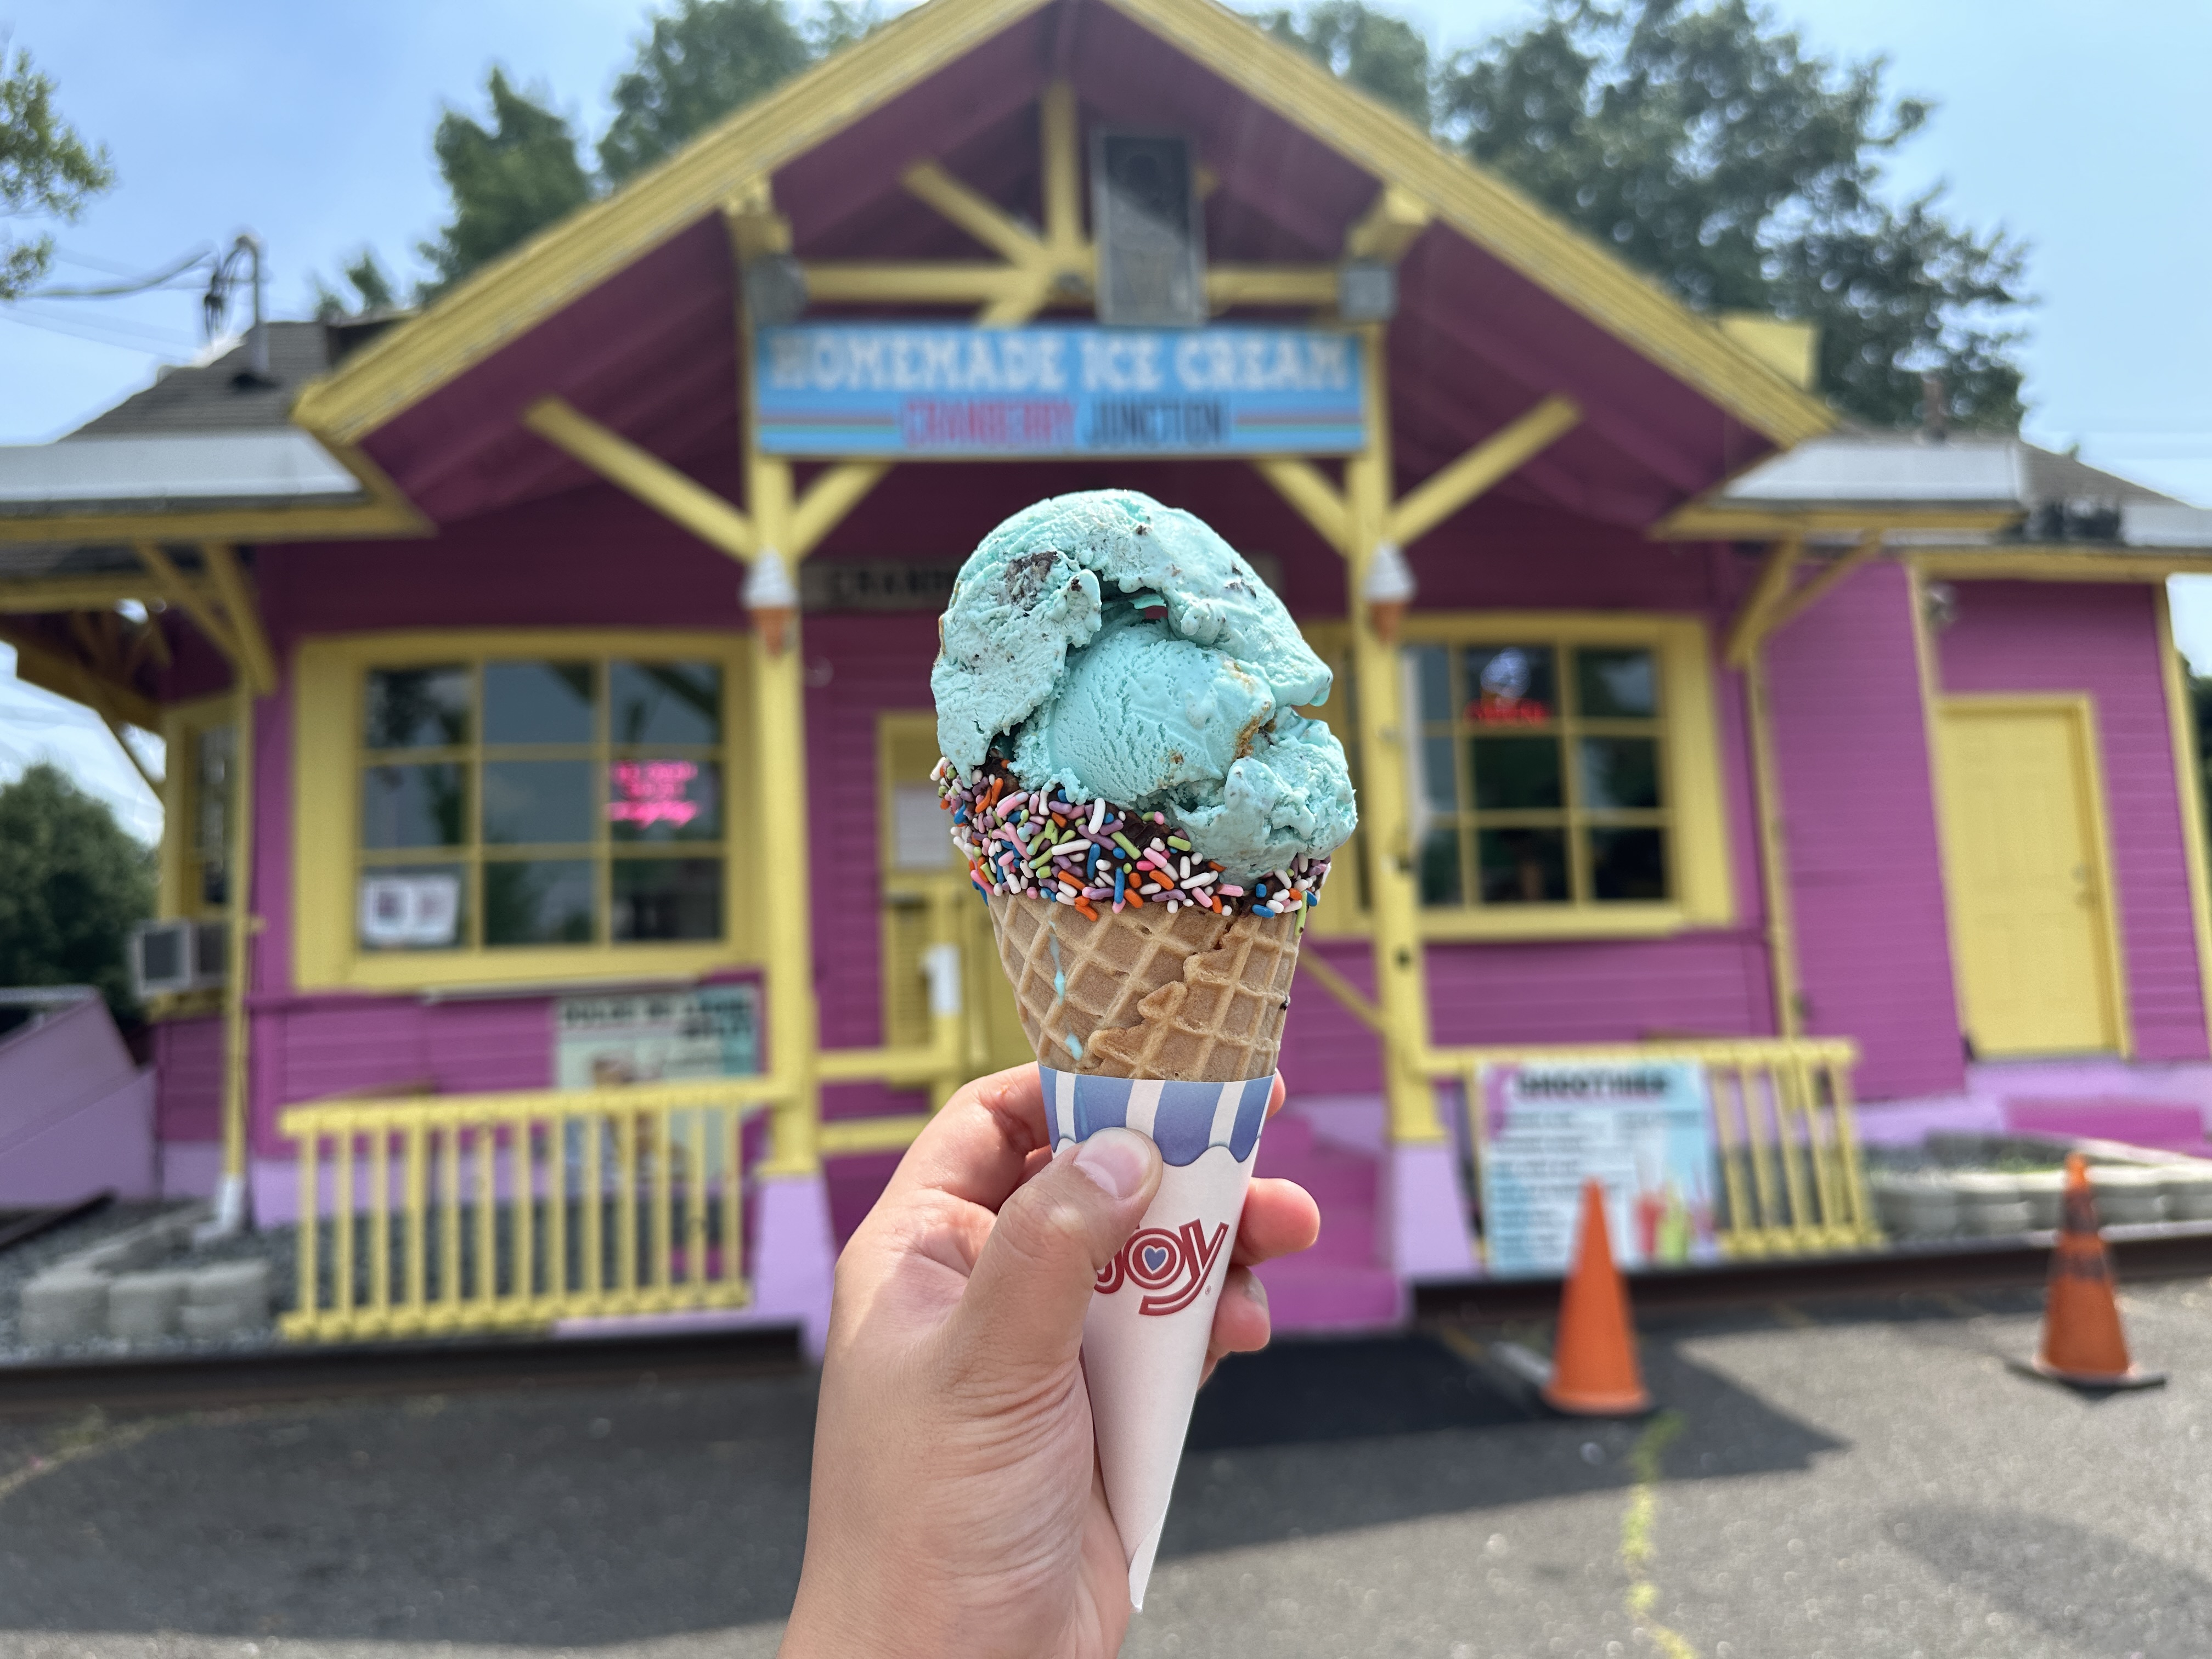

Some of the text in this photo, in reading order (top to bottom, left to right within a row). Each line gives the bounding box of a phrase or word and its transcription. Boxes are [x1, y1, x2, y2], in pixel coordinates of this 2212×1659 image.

[770, 329, 1351, 392] HOMEMADE ICE CREAM
[901, 396, 1228, 449] CRANBERRY JUNCTION
